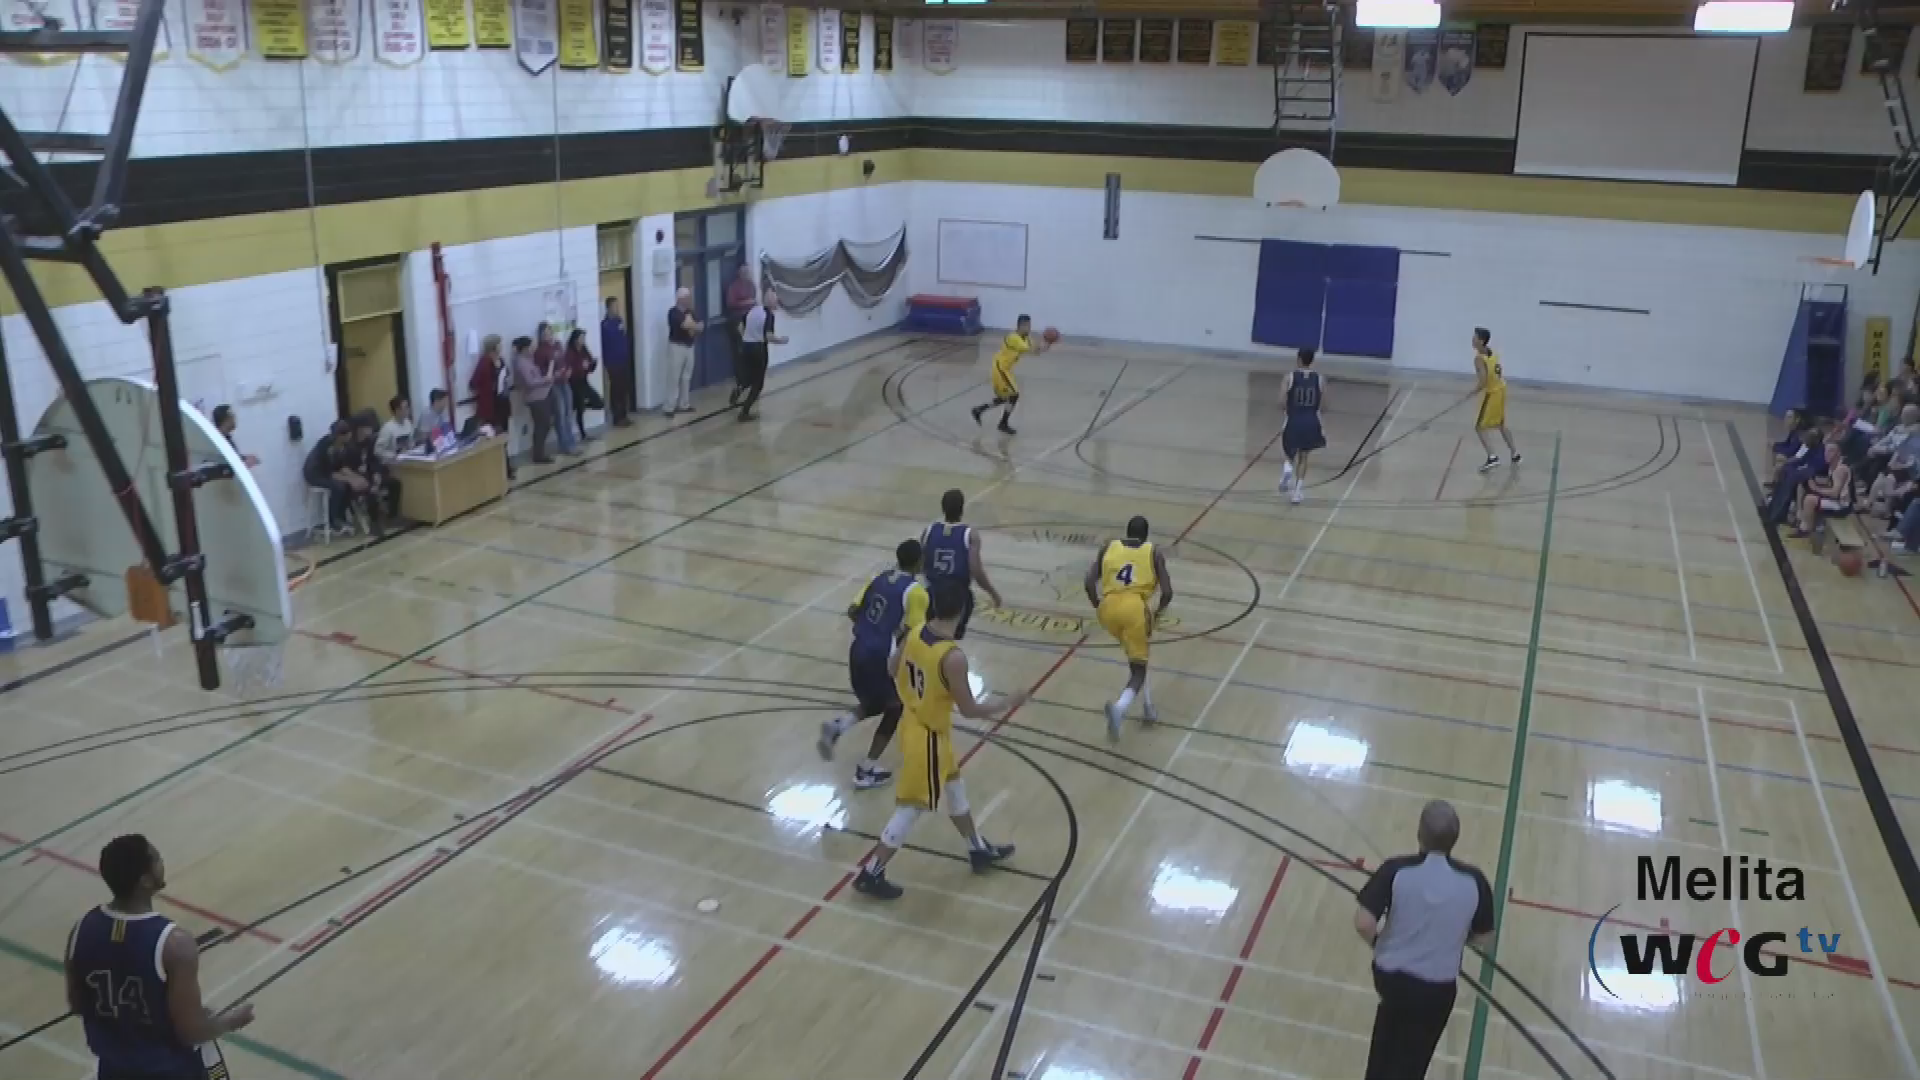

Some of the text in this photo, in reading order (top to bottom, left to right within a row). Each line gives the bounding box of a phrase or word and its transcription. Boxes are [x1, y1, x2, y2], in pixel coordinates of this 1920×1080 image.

[933, 548, 956, 575] 5
[1115, 563, 1134, 585] 4
[904, 659, 925, 700] 13
[85, 968, 153, 1026] 14
